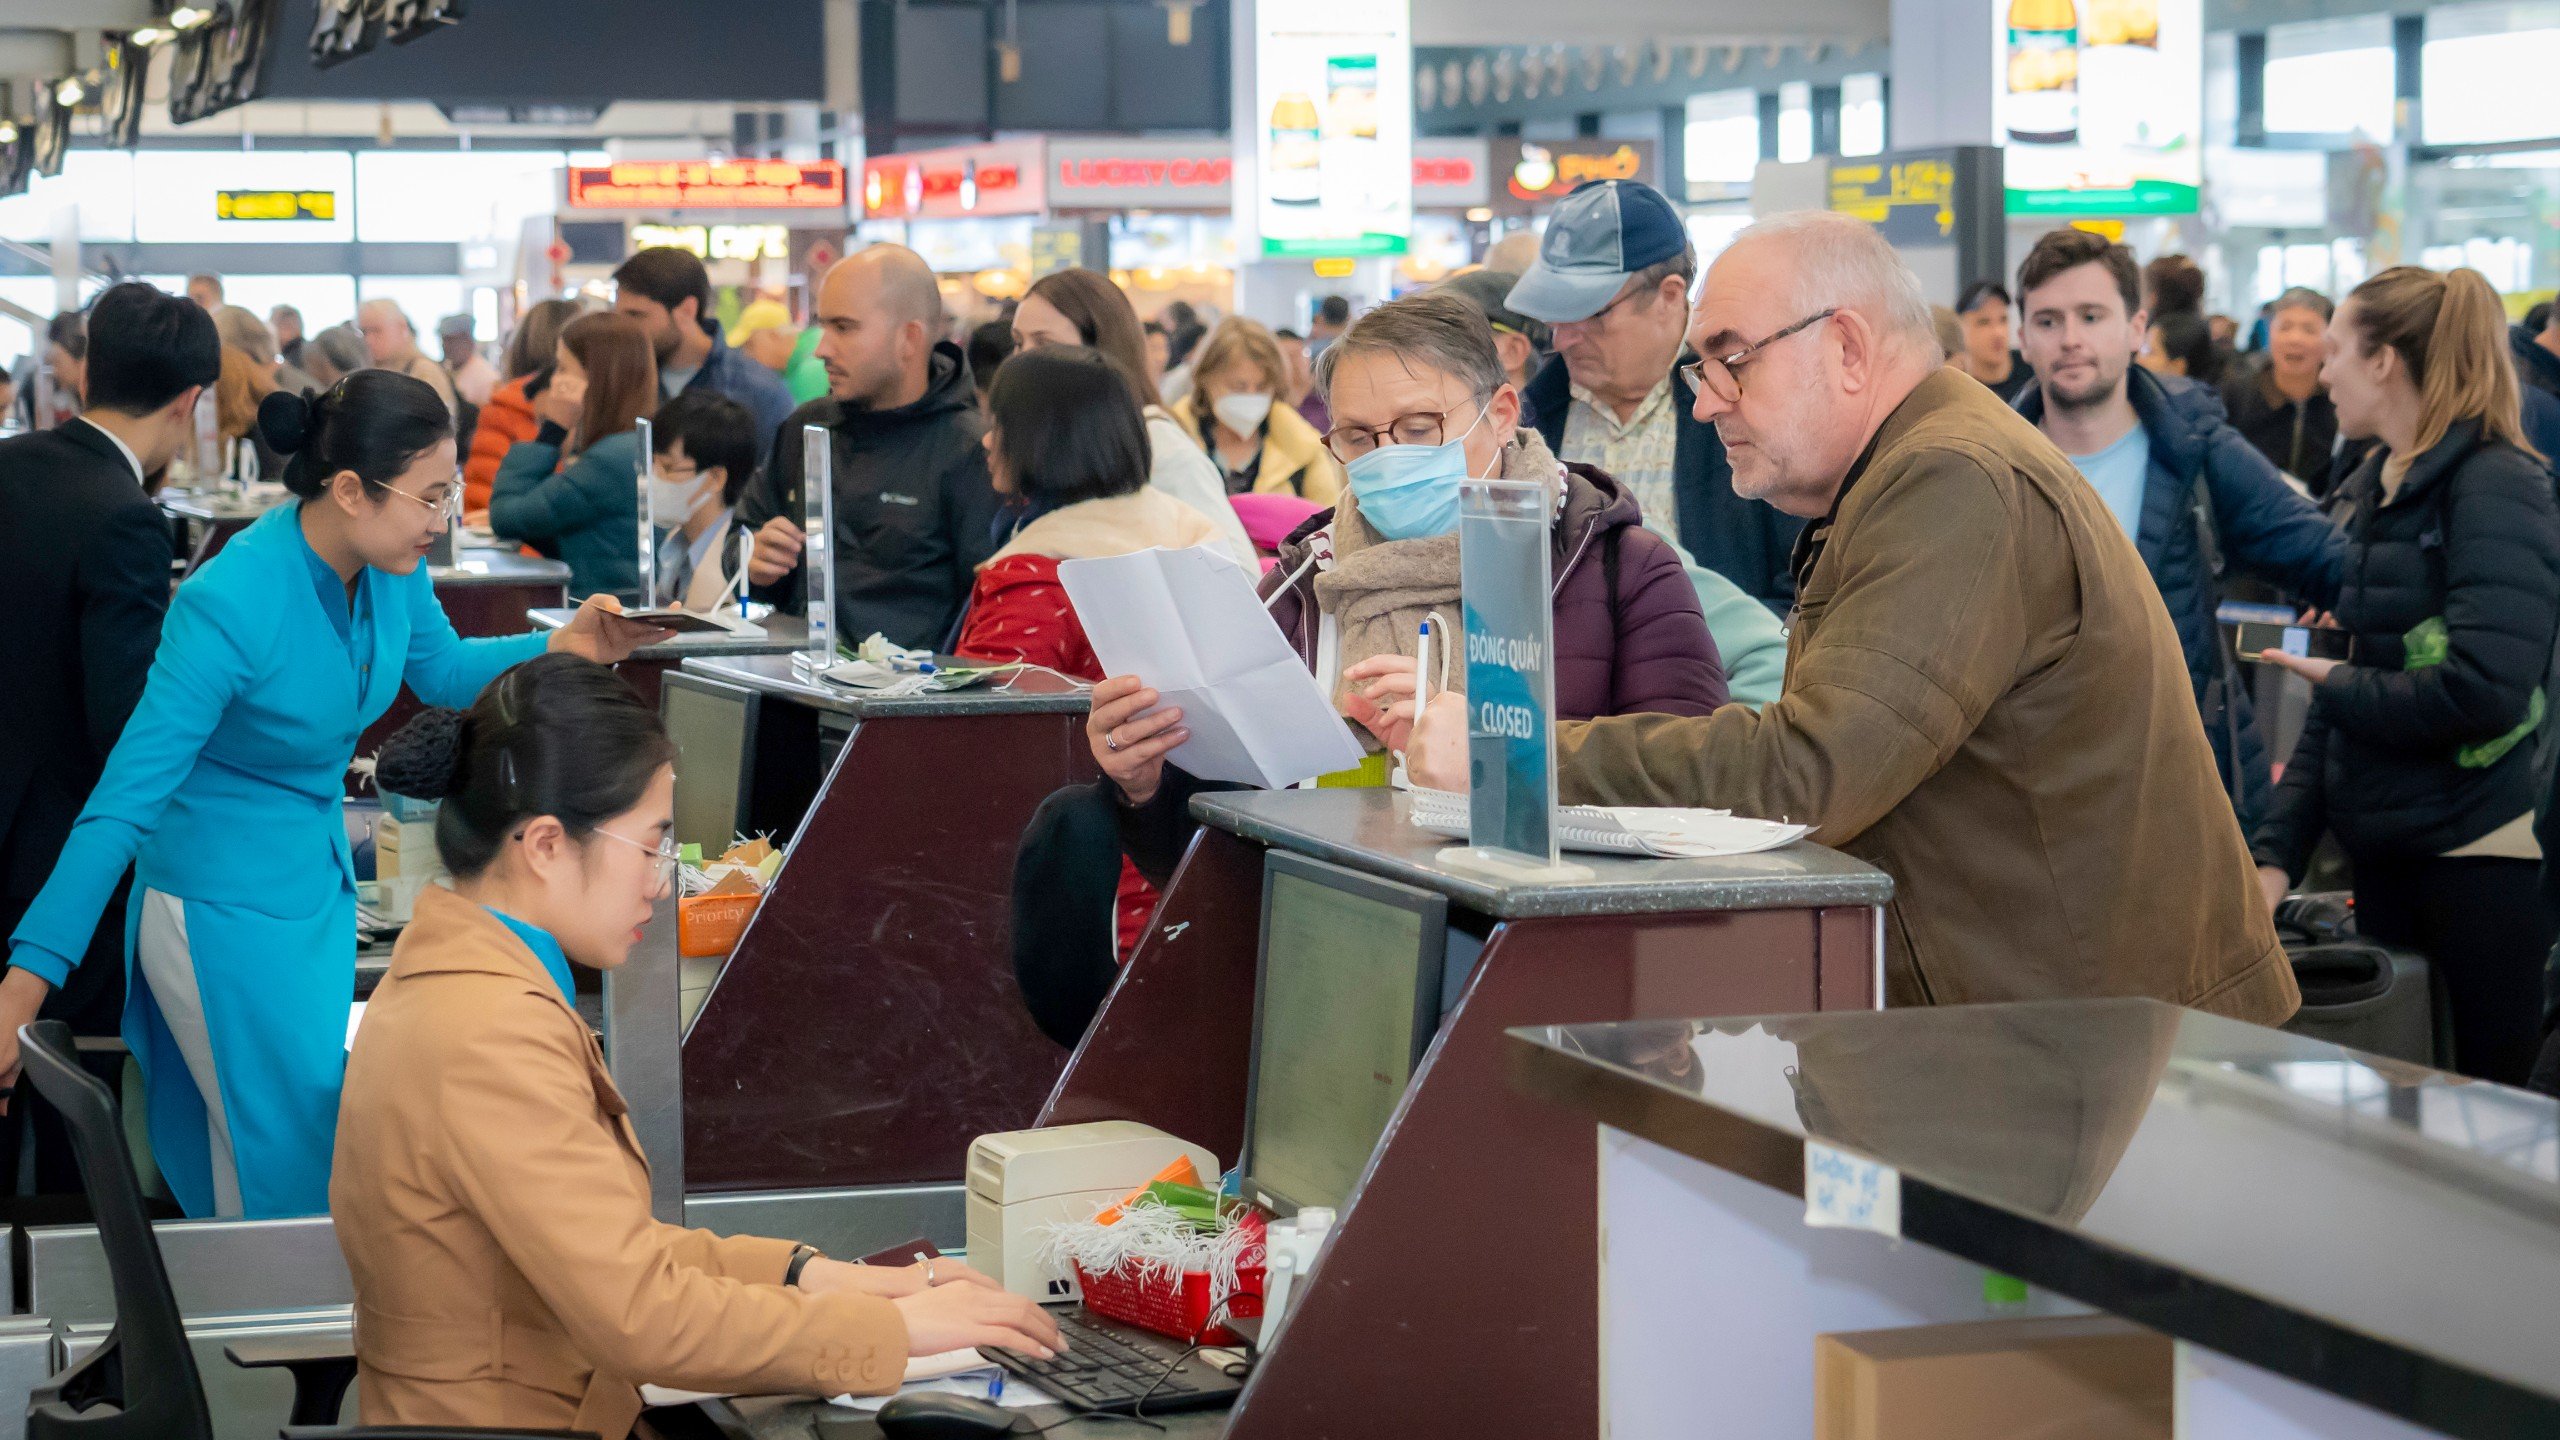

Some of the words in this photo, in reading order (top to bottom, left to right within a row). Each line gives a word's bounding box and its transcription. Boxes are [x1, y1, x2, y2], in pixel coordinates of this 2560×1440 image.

[1061, 158, 1168, 188] LUCKY
[1469, 629, 1506, 666] ĐÓNG
[1481, 701, 1532, 739] CLOSED
[686, 907, 744, 924] Priority
